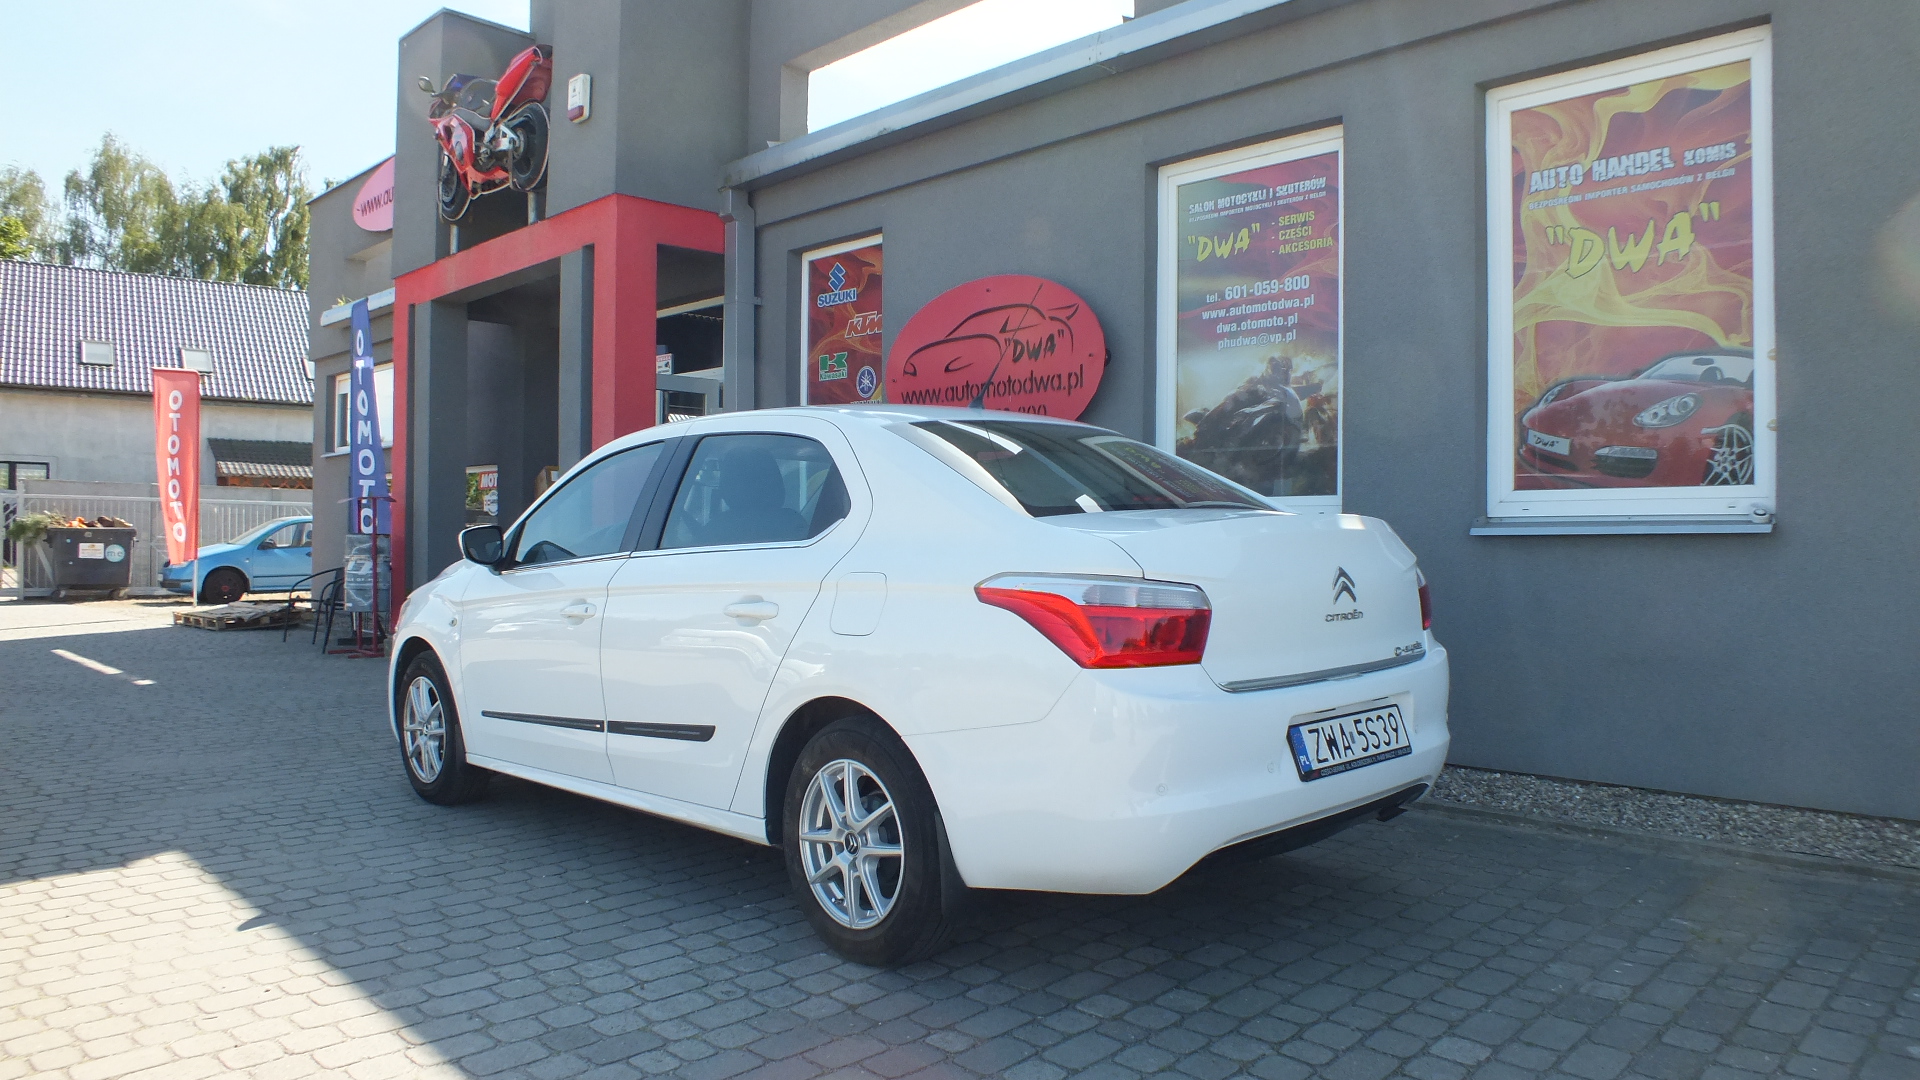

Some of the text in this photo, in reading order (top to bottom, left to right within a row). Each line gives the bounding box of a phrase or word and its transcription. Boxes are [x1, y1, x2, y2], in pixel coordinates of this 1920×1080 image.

[1529, 142, 1737, 195] AUTO HANDEL KOMIS
[1188, 200, 1215, 215] SALON
[1218, 188, 1267, 209] MOTOCYKLI
[1275, 174, 1326, 198] SKUTERÓW
[1278, 211, 1315, 226] SERWIS
[1278, 225, 1312, 241] CZĘŚCI
[1187, 222, 1260, 262] "DWA"
[1278, 237, 1334, 255] AKCESORIA
[1545, 201, 1720, 279] "DWA"
[817, 288, 857, 307] SUZUKI
[1206, 274, 1310, 303] tel. 601-059-800
[1201, 294, 1315, 320] www.automotodwa.pl
[1216, 312, 1298, 334] dwa.otomoto.pl
[1003, 328, 1065, 363] "DWA"
[1218, 329, 1297, 350] phudwa@vp.pl
[819, 370, 848, 382] Kawasaki
[901, 363, 1084, 405] www.automotodwa.pl
[355, 329, 376, 534] OTOMOTO
[167, 389, 187, 543] OTOMOTO
[1307, 722, 1355, 764] ZWA
[1353, 712, 1399, 752] 5S39
[1300, 755, 1310, 766] PL
